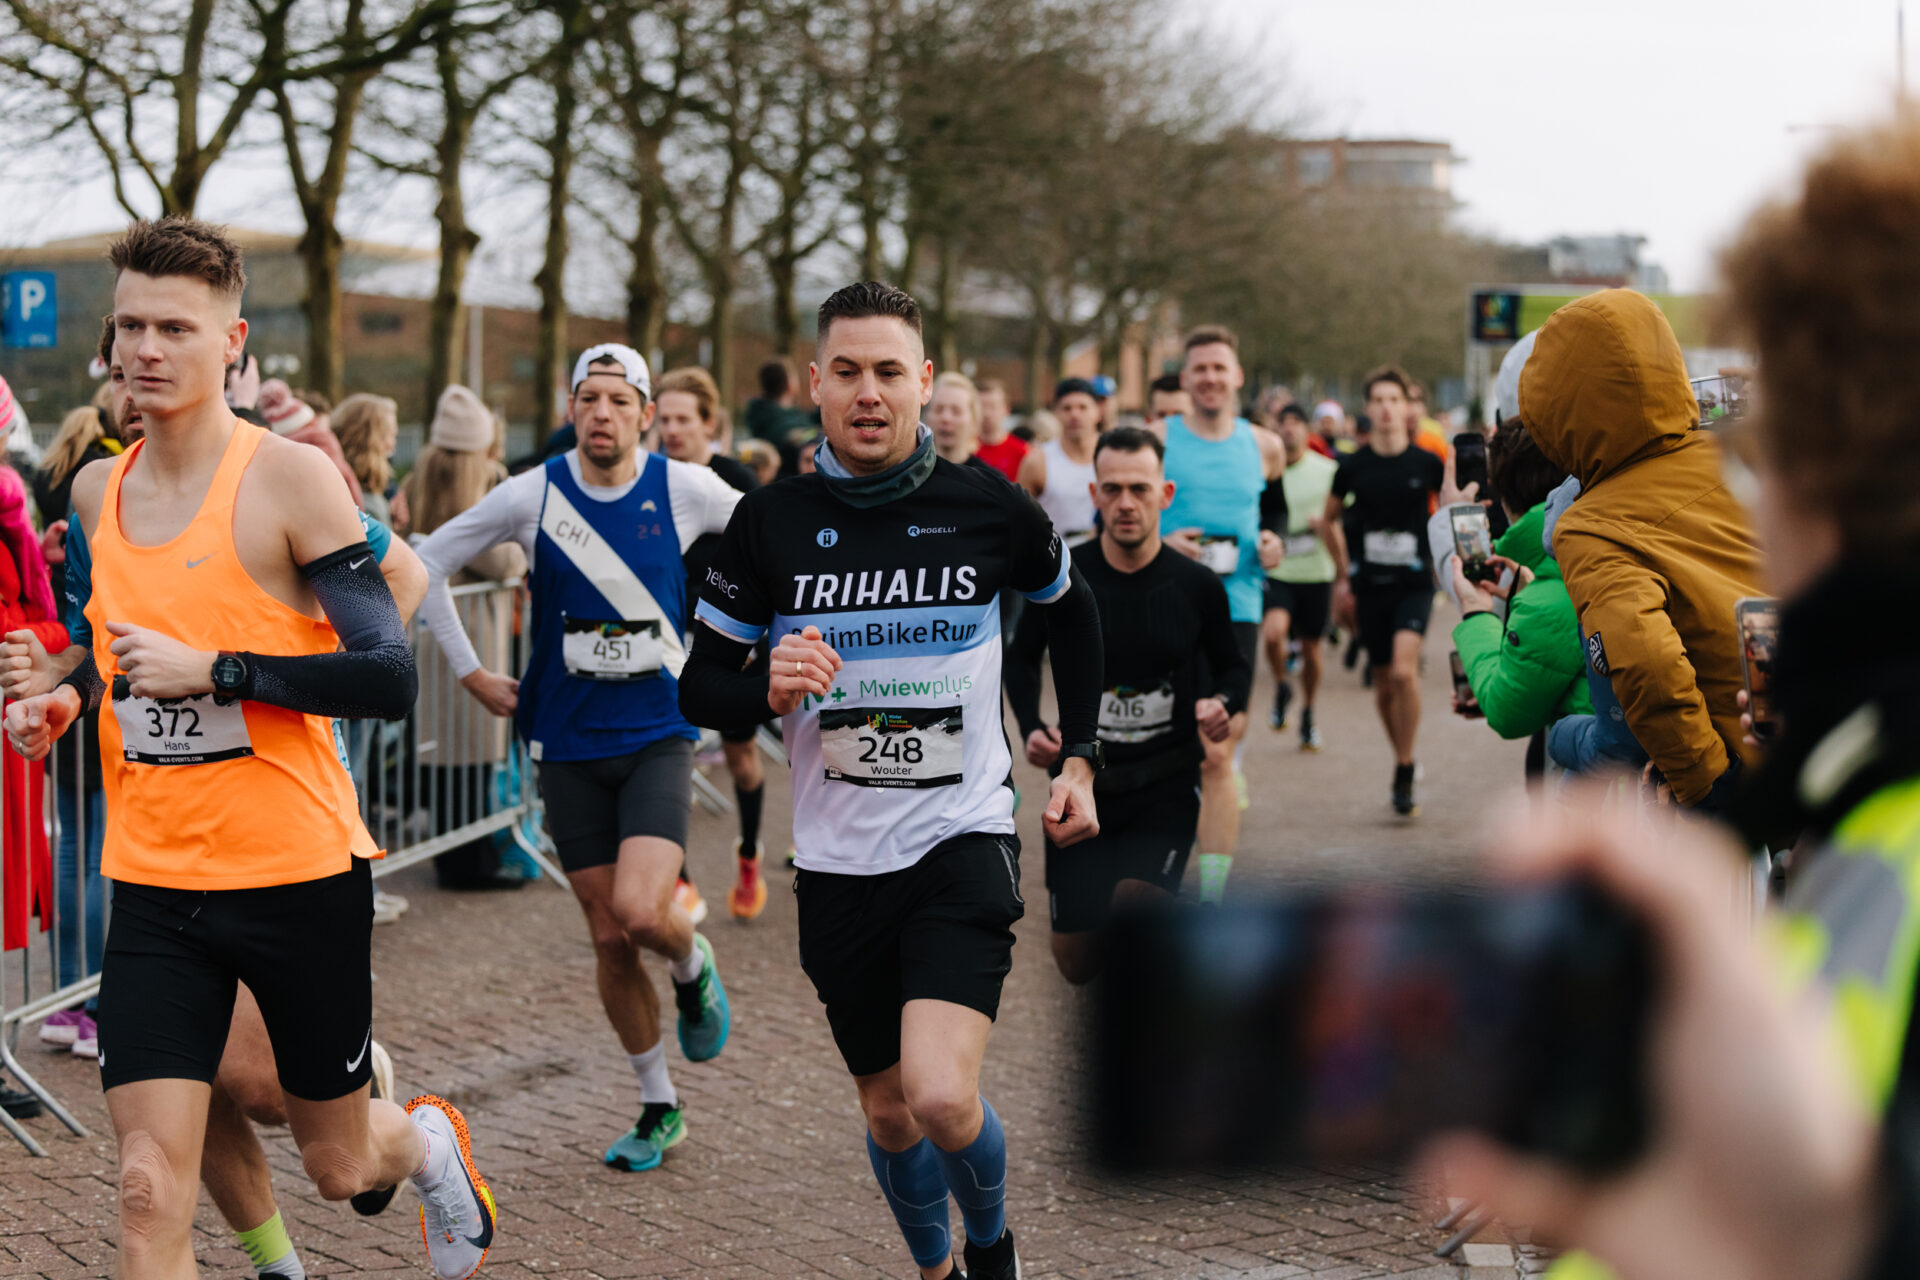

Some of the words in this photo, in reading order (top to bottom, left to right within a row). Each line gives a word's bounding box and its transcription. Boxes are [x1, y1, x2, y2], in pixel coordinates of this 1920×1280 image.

[20, 279, 46, 322] P
[555, 520, 592, 548] CHI
[793, 565, 977, 610] TRIHALIS
[593, 640, 631, 661] 451
[859, 674, 973, 700] Mviewplus
[145, 707, 204, 738] 372
[1106, 700, 1145, 718] 416
[164, 741, 191, 751] Hans
[858, 735, 924, 764] 248
[870, 765, 912, 776] Wouter
